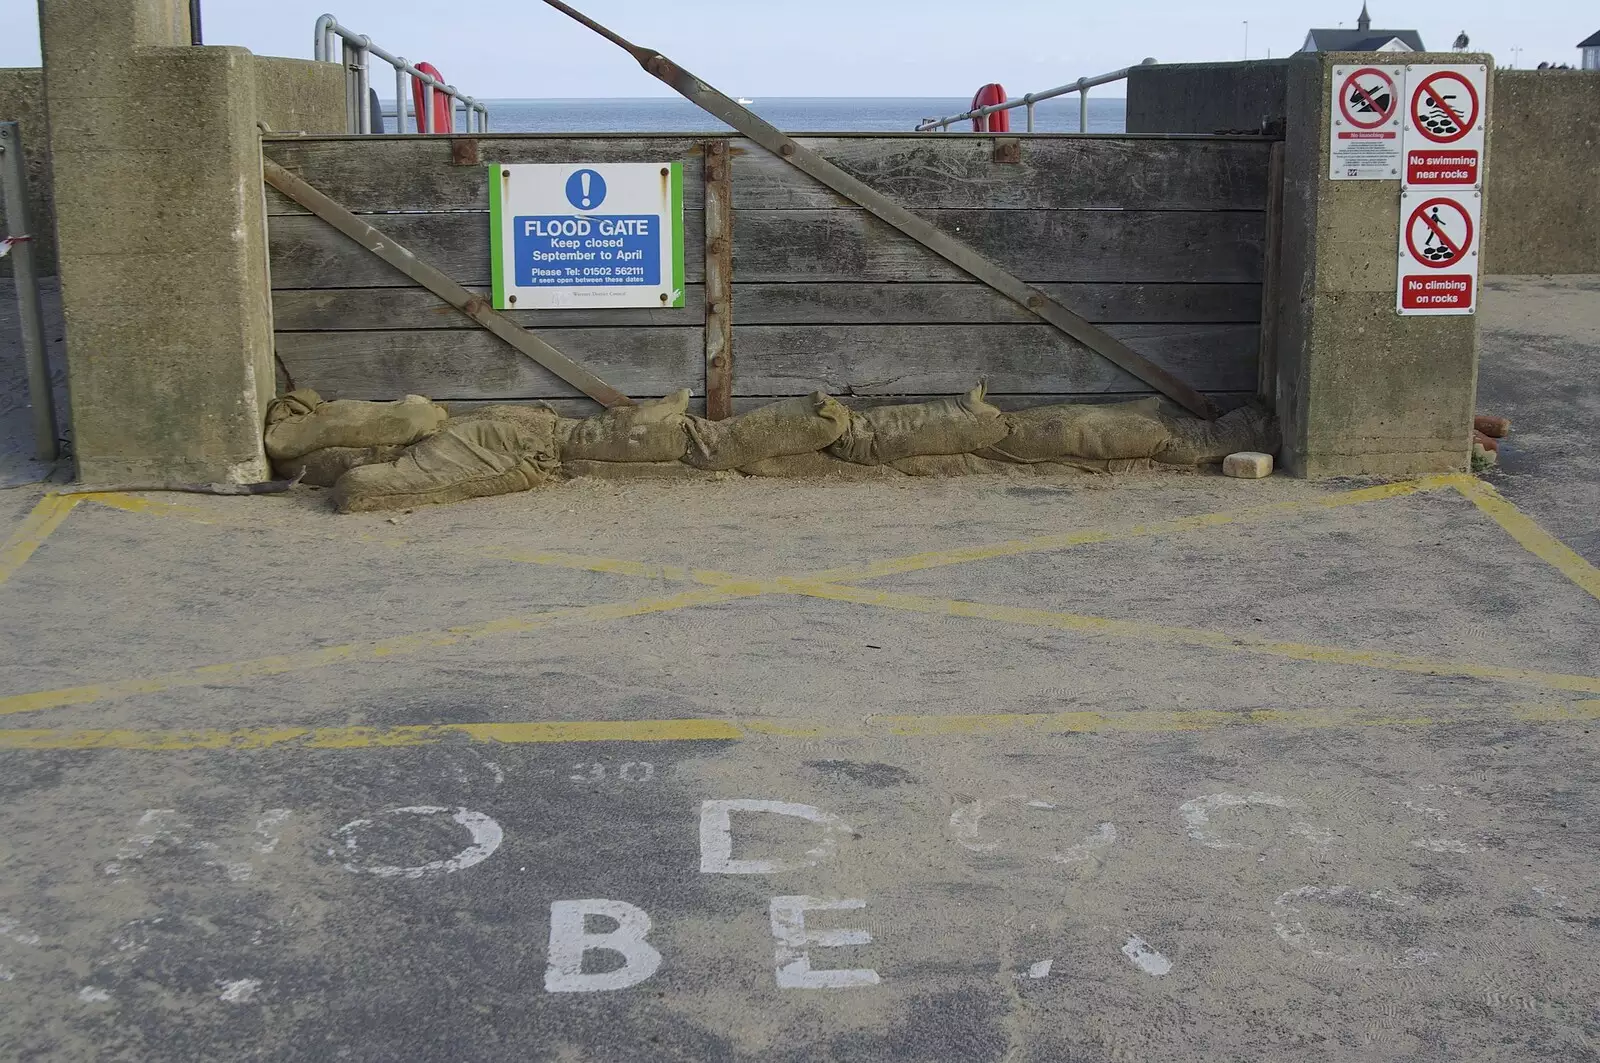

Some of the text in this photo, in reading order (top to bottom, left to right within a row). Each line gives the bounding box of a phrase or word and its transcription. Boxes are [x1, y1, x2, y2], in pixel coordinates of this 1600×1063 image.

[1410, 156, 1476, 167] No swimming
[1416, 170, 1468, 179] near rocks
[524, 219, 648, 236] FLOOD GATE
[551, 237, 623, 249] Keep closed
[533, 250, 642, 262] September to April
[532, 267, 643, 276] Please Tel: 01502 562111
[1409, 280, 1466, 292] No climbing
[1416, 294, 1458, 303] on rocks
